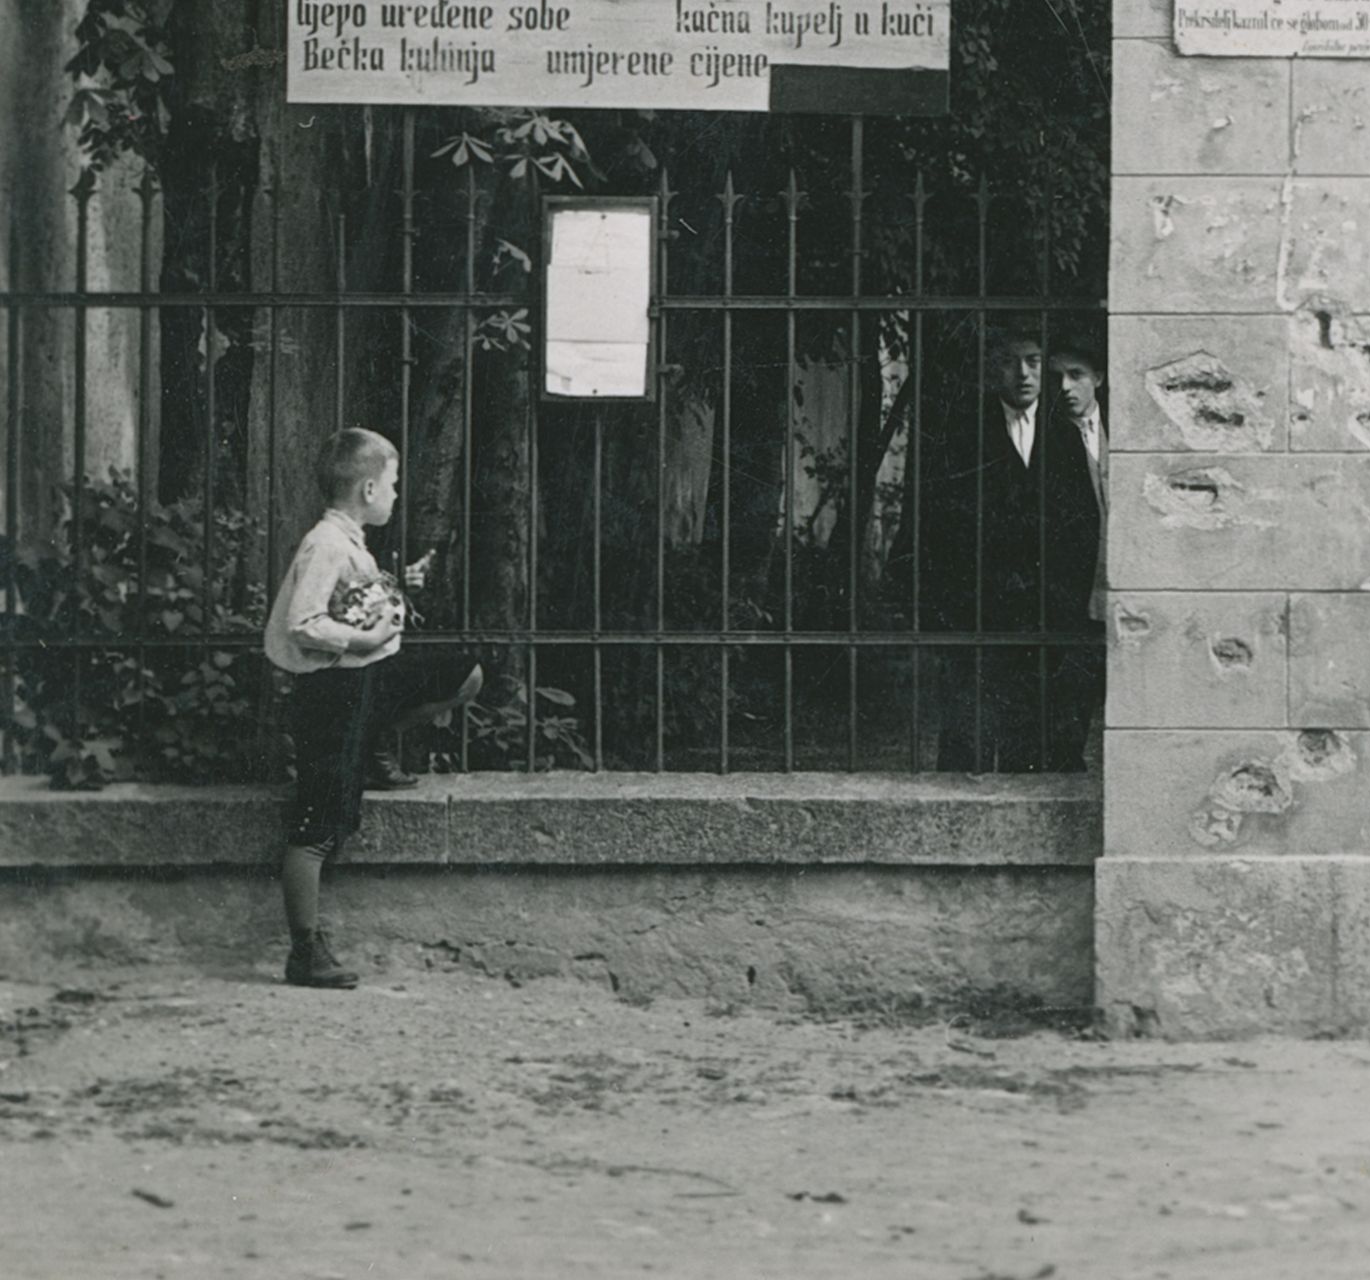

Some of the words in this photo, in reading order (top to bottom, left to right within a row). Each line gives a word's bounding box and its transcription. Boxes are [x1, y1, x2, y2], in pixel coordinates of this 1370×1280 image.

[766, 1, 843, 49] kupelj
[855, 12, 870, 36] u
[401, 35, 496, 87] kuhinja
[547, 43, 674, 88] umjerene
[690, 47, 770, 89] cijene
